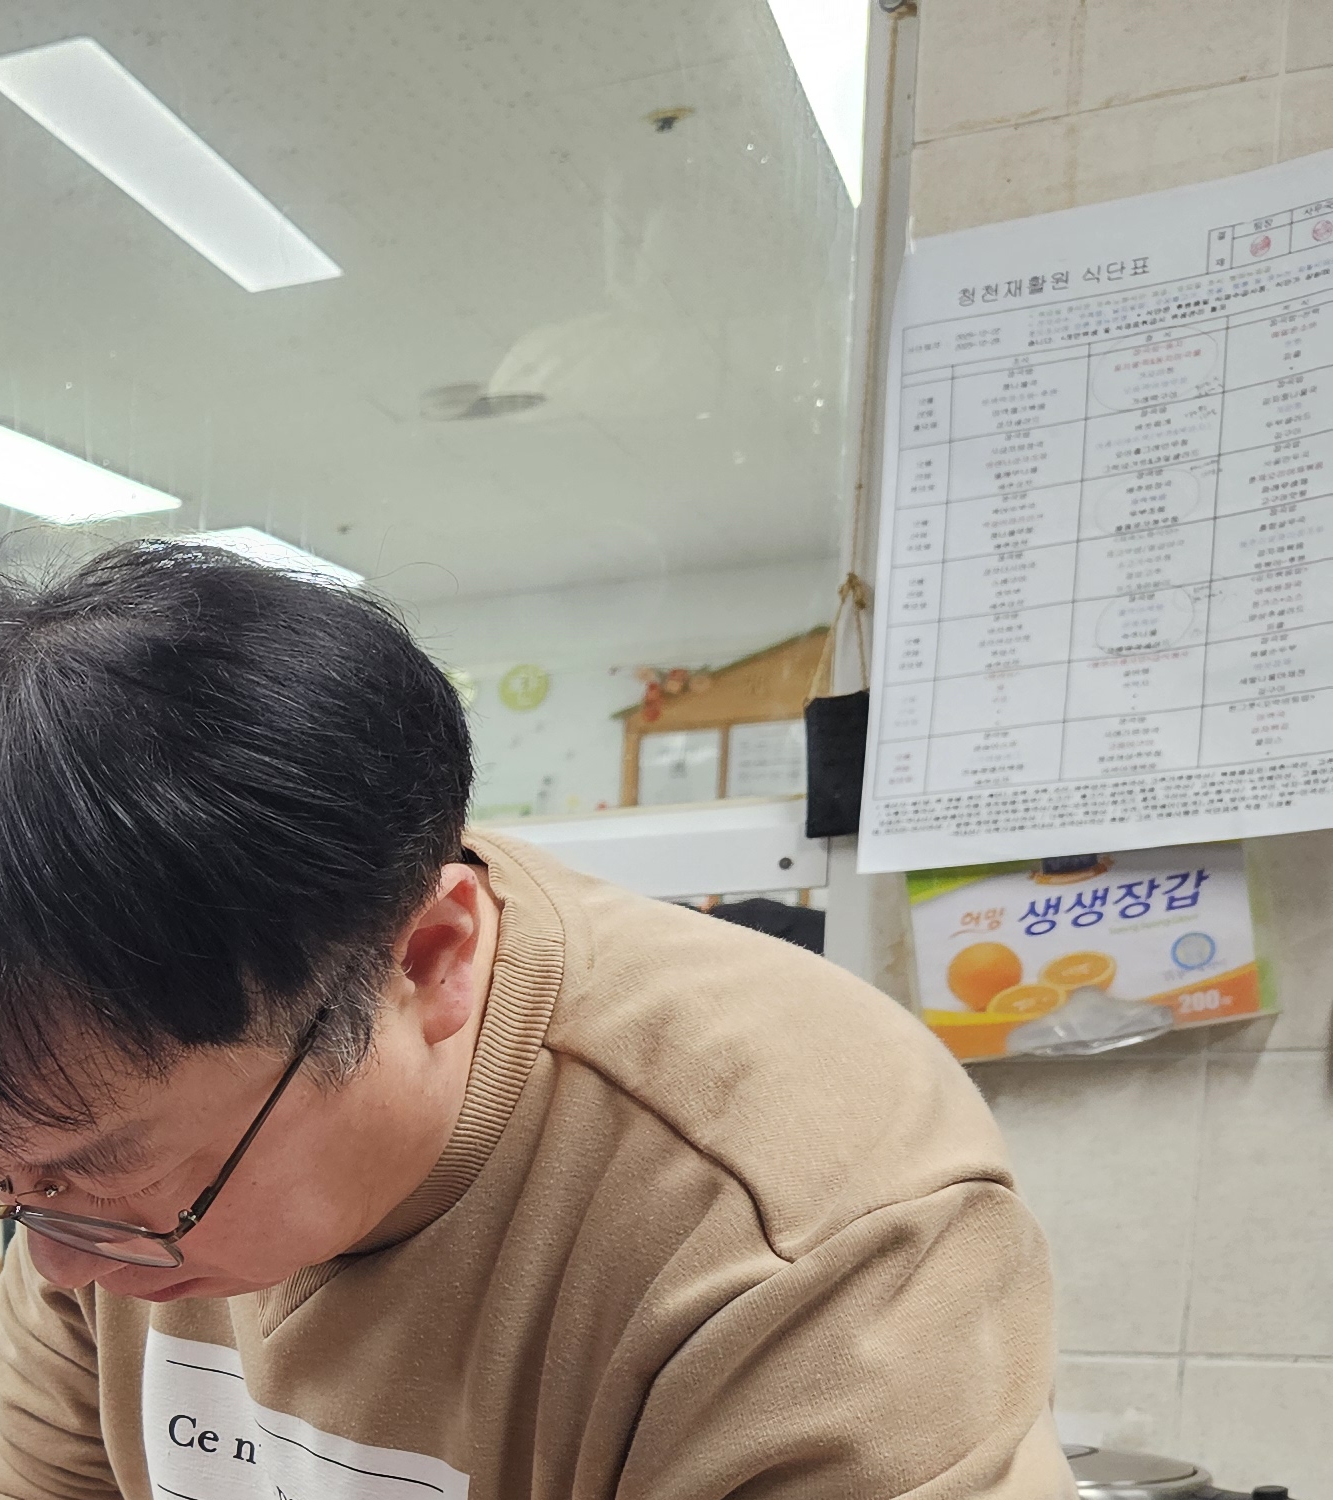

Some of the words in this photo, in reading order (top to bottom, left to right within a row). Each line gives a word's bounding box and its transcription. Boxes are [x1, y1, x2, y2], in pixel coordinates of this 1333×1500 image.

[1082, 256, 1150, 284] 식단표
[1018, 868, 1211, 937] 생생장갑
[1179, 990, 1219, 1014] 200
[168, 1414, 219, 1454] Ce
